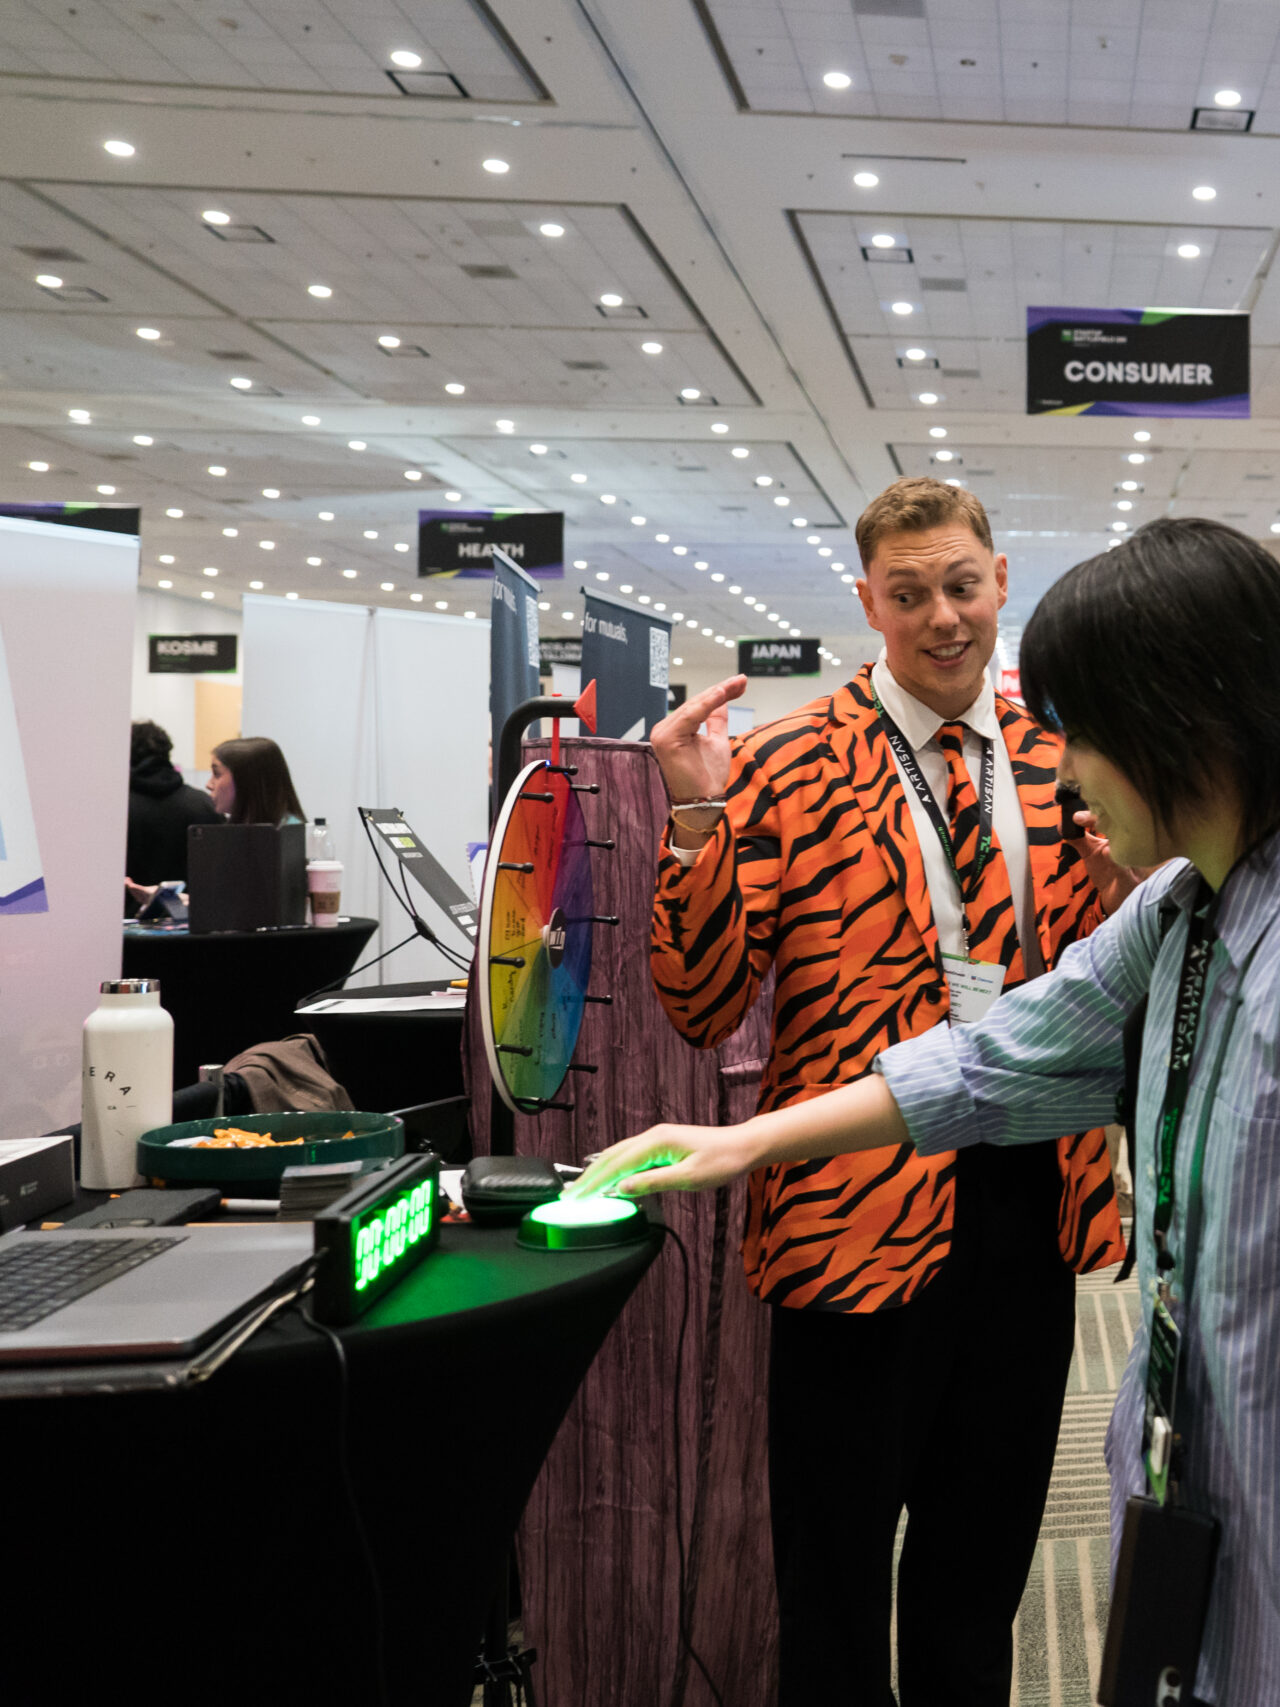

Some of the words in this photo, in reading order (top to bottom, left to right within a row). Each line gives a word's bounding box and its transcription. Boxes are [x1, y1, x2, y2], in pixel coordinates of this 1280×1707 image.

[1064, 360, 1213, 385] CONSUMER
[458, 543, 525, 558] HEATH
[584, 612, 597, 633] for
[157, 640, 218, 655] KOSME
[752, 643, 802, 659] JAPAN
[889, 735, 926, 791] ARTISAN
[984, 758, 995, 814] ARTISAN
[82, 1066, 132, 1096] ERA
